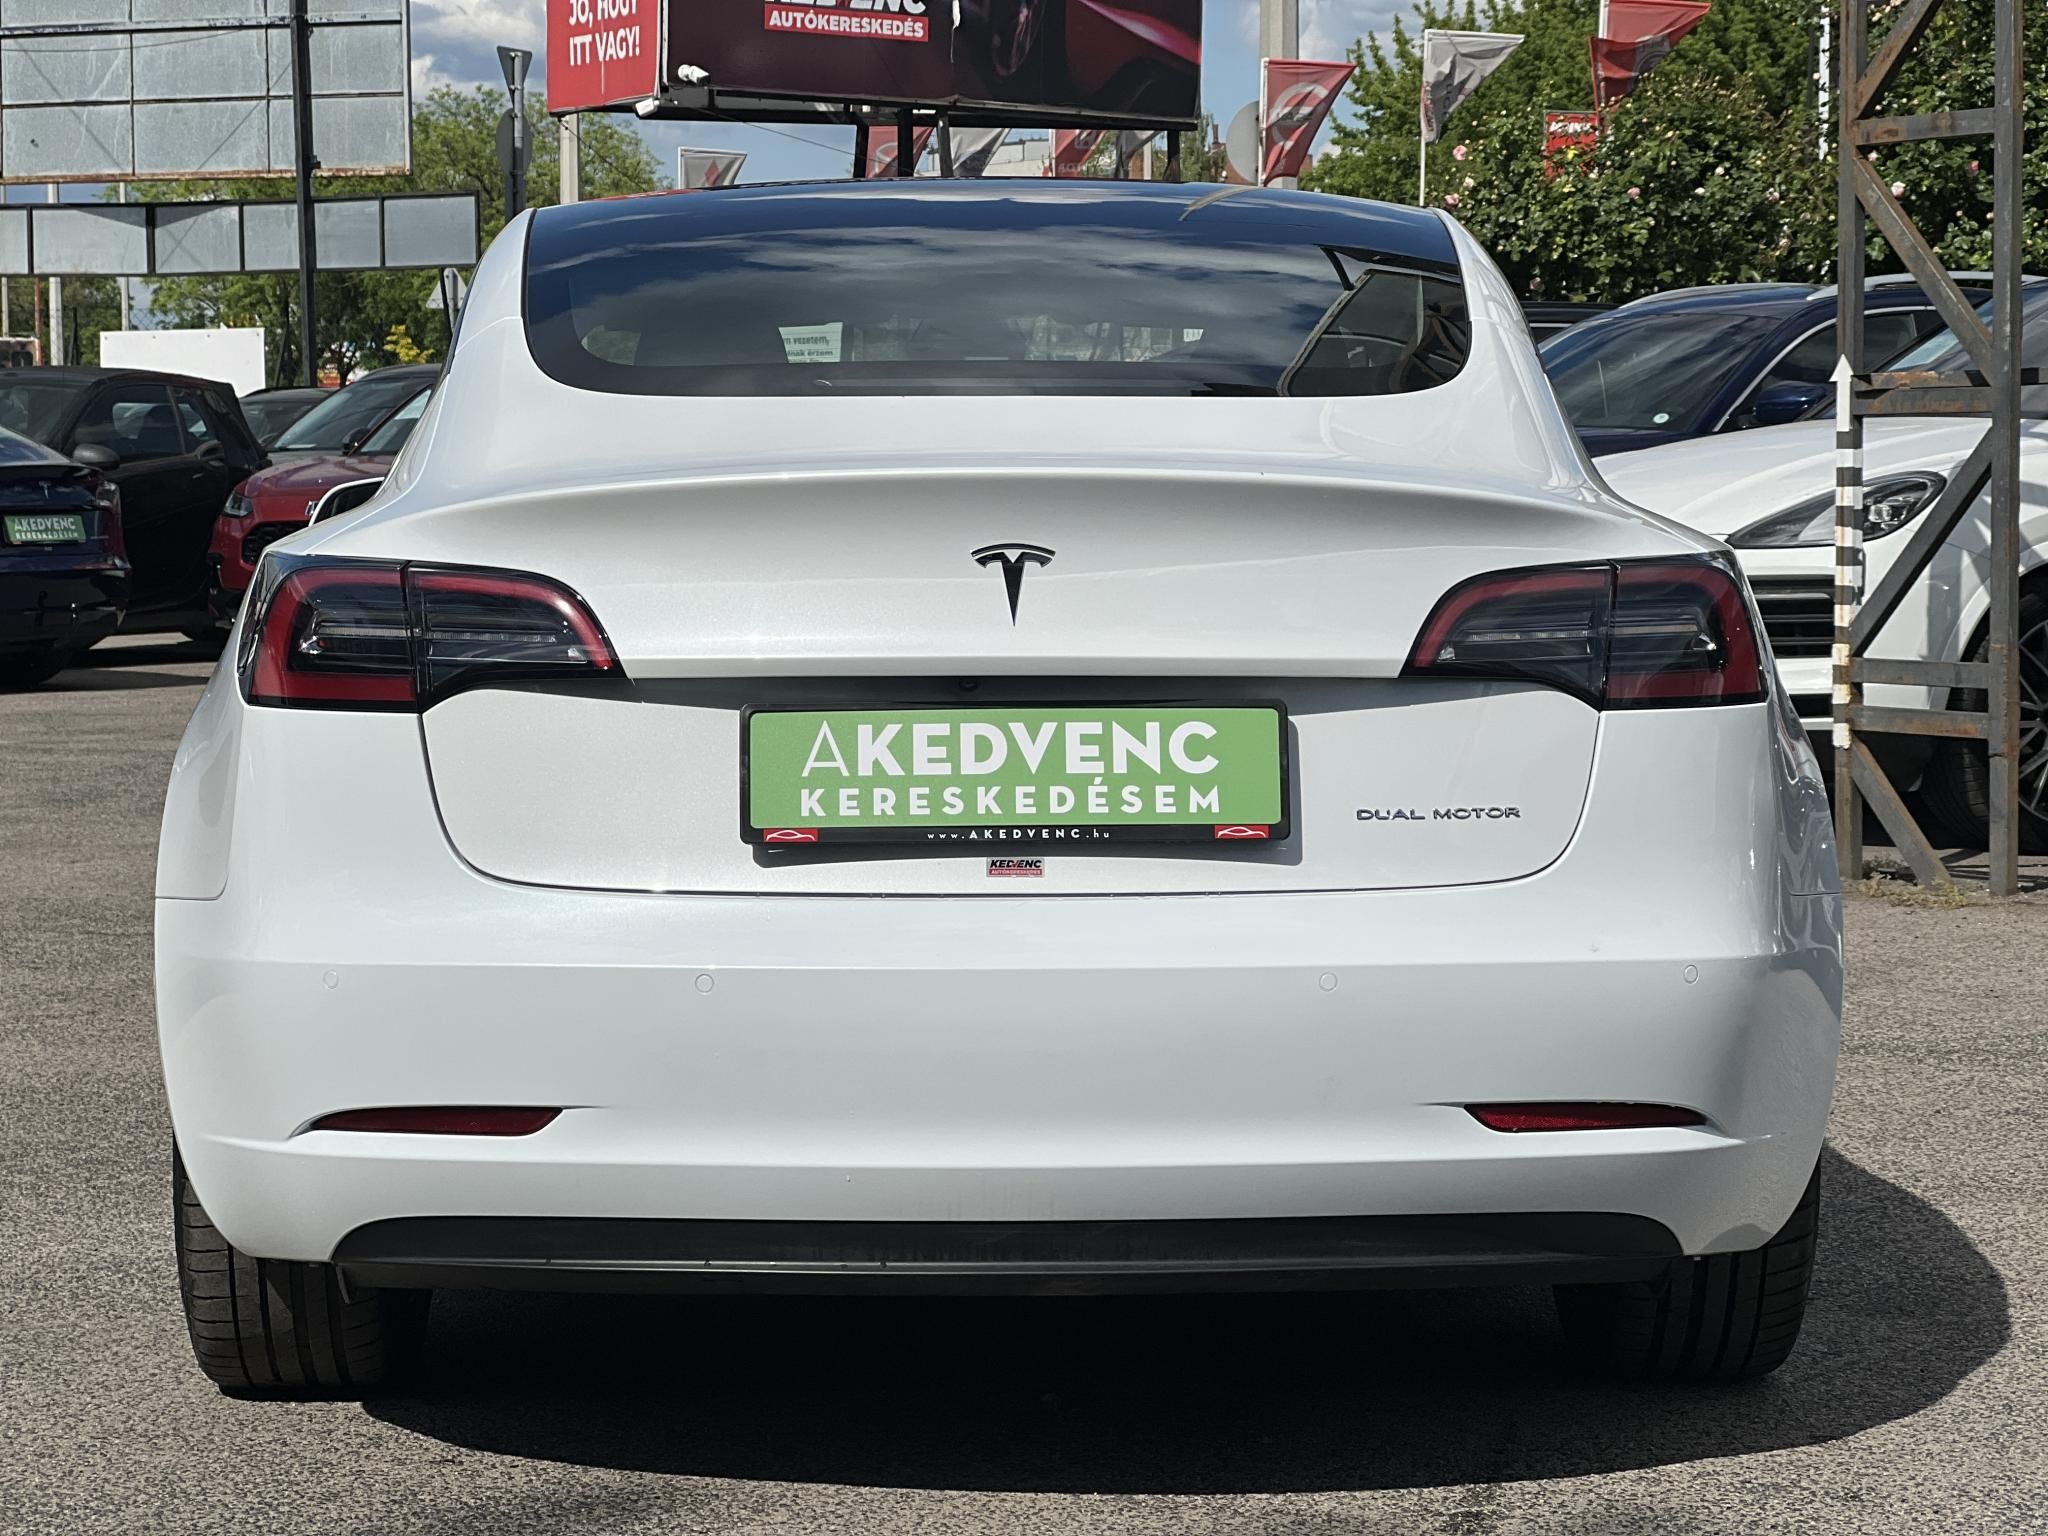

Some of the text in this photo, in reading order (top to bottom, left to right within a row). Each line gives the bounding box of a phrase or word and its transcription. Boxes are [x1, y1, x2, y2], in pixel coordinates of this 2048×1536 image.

[769, 9, 924, 38] AUTÓKERESKEDÉS
[569, 25, 640, 66] ITT VAGY!
[14, 518, 76, 531] AKEDVENC
[800, 777, 1220, 817] KERESKEDÉSEM
[1356, 807, 1521, 820] DUAL MOTOR
[927, 829, 1111, 839] www.AKEDVENC.hu
